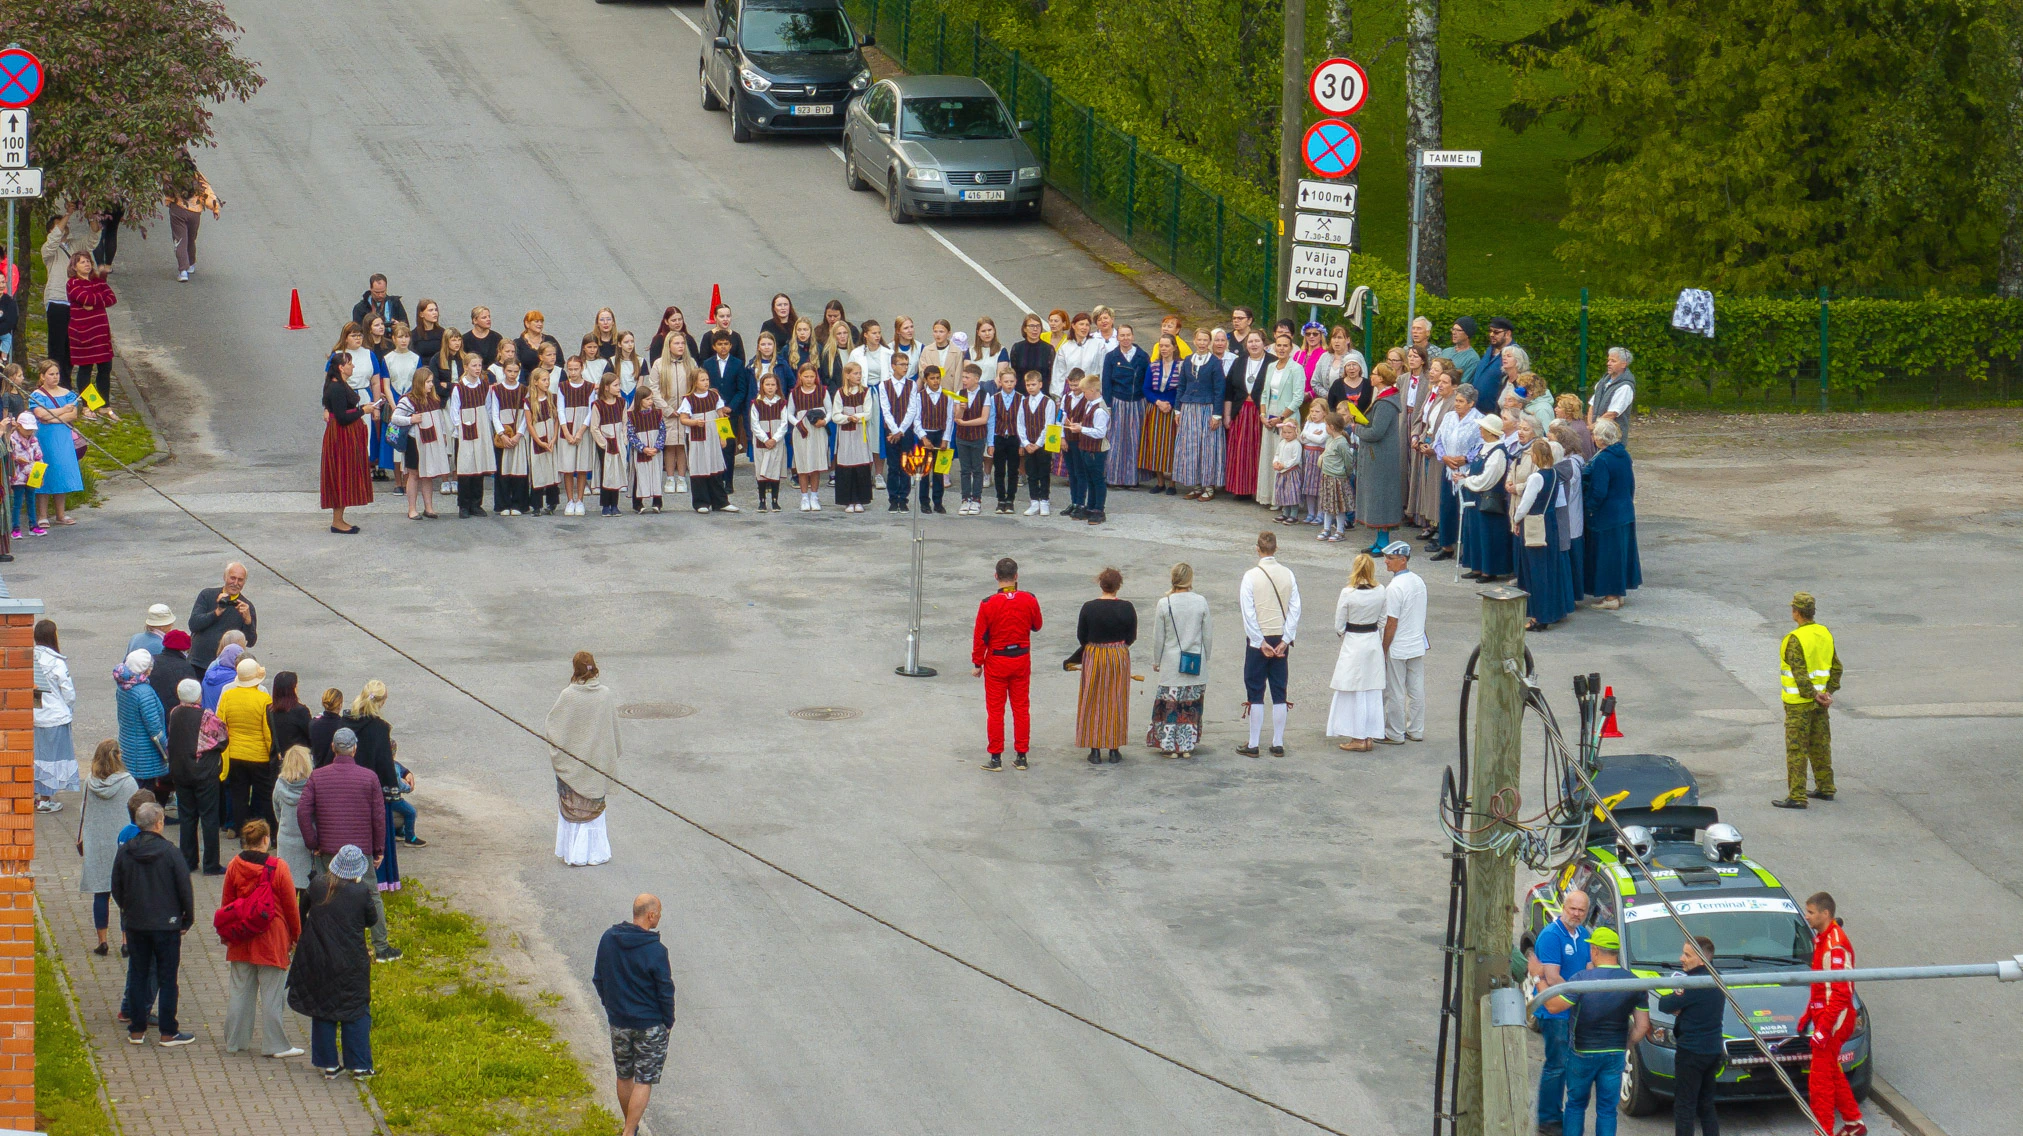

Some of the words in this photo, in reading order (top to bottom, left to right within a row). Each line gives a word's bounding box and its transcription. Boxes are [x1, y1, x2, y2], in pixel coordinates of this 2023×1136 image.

[1321, 73, 1355, 102] 30
[797, 106, 811, 114] 923
[815, 106, 832, 114] BYD
[2, 136, 24, 149] 100
[7, 152, 20, 163] m
[1429, 154, 1464, 163] TAMME
[1466, 154, 1476, 163] tn
[968, 191, 981, 199] 416
[986, 191, 1002, 199] TJN
[1311, 190, 1343, 203] 100m
[1305, 251, 1337, 266] Välja
[1295, 265, 1344, 279] arvatud
[1697, 900, 1746, 910] Terminal
